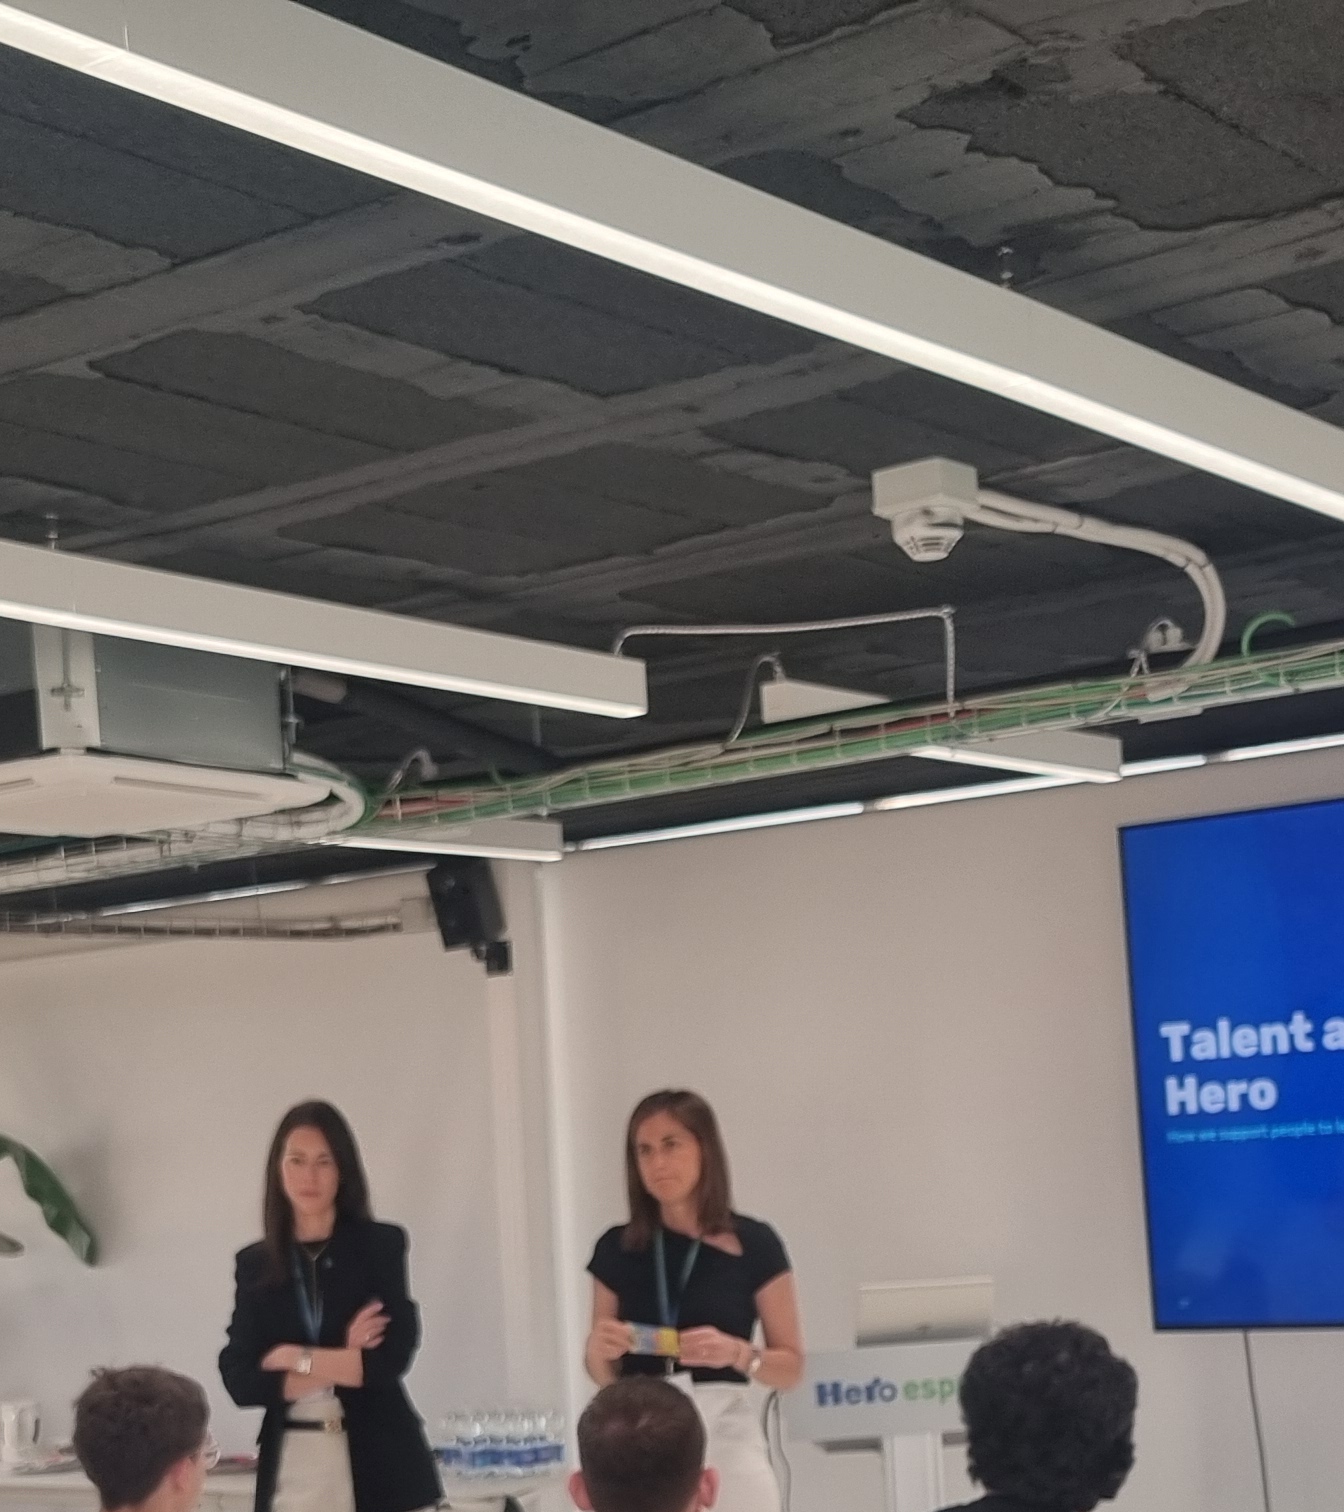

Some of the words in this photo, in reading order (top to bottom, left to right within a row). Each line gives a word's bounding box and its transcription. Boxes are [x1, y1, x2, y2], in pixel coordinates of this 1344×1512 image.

[1159, 1009, 1316, 1063] Talent
[1164, 1073, 1279, 1117] Hero
[817, 1376, 898, 1406] Hero
[904, 1378, 960, 1405] esp
